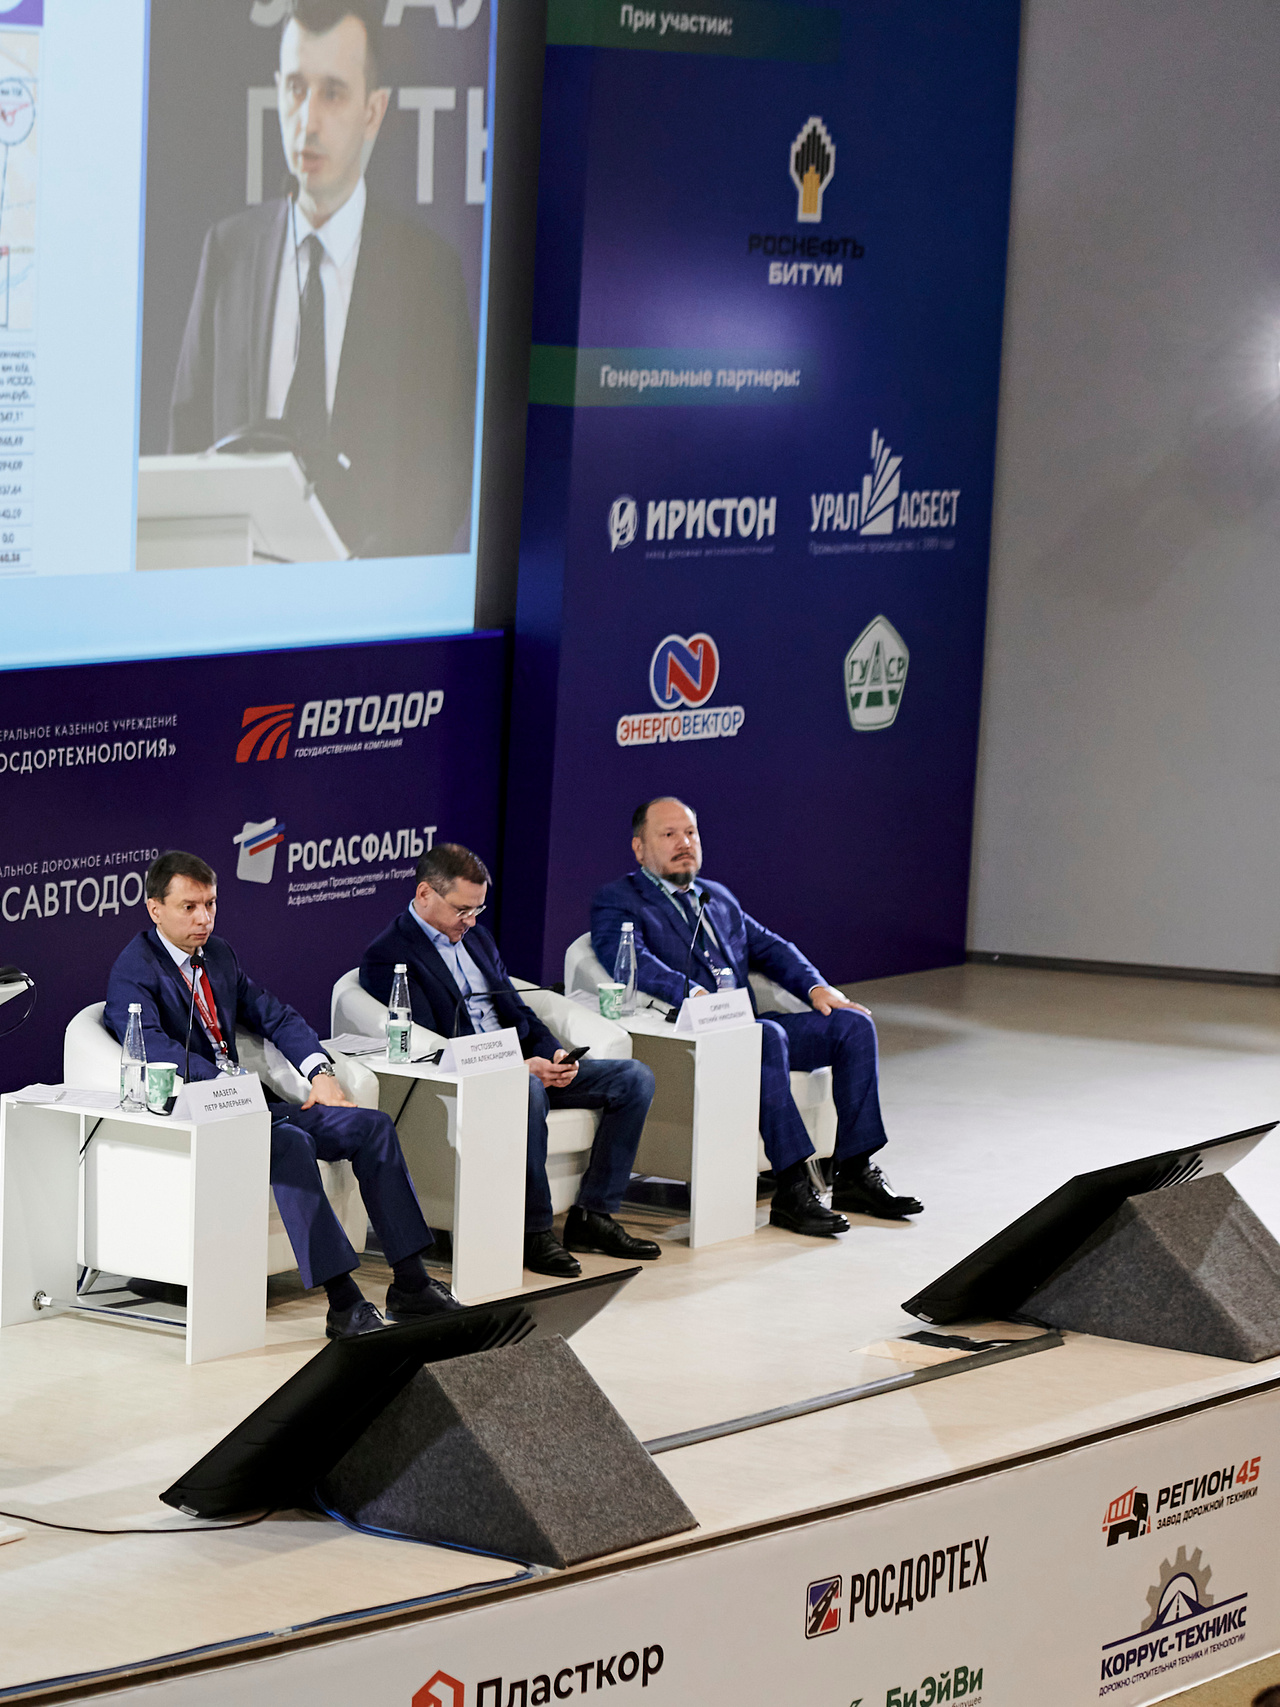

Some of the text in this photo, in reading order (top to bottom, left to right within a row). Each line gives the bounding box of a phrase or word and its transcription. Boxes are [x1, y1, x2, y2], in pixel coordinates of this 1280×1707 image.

[620, 5, 733, 36] При участии:
[748, 233, 865, 259] РОСНЕФТЬ
[768, 262, 843, 287] БИТУМ
[600, 365, 800, 391] Генеральные партнеры:
[646, 496, 777, 542] ИРИСТОН
[54, 721, 109, 738] КАЗЕННОЕ
[113, 714, 178, 731] УЧРЕЖДЕНИЕ
[298, 690, 444, 739] АВТОДОР
[620, 712, 742, 742] ЭНЕРГОВЕКТОР
[294, 738, 403, 758] ГОСУДАРСТВЕННАЯ КОМПАНИЯ
[41, 856, 101, 875] ДОРОЖНОЕ
[104, 848, 159, 866] АГЕНТСТВО
[288, 826, 437, 873] РОСАСФАЛЬТ
[287, 885, 376, 906] Асфальтобетонных Смесей
[288, 879, 328, 893] Ассоциация
[329, 871, 384, 888] Производителей
[461, 1050, 517, 1065] ПАВЕЛ АЛЕКСАНДРОВИЧ
[471, 1040, 503, 1052] ПУСТОЗЕРОВ
[204, 1098, 253, 1112] ПЕТР ВАЛЕРЬЕВИЧ
[212, 1088, 238, 1098] МАЗЕПА
[1156, 1456, 1261, 1514] РЕГИОН 45
[1157, 1486, 1258, 1530] ЗАВОД ДОРОЖНОЙ ТЕХНИКИ
[849, 1535, 990, 1623] РОСДОРТЕХ
[1101, 1606, 1247, 1680] КОРРУС-ТЕХНИКС
[1178, 1652, 1203, 1665] ТЕХНИКА
[1204, 1649, 1208, 1657] И
[1210, 1633, 1245, 1653] ТЕХНОЛОГИИ
[475, 1644, 664, 1707] Пласткор
